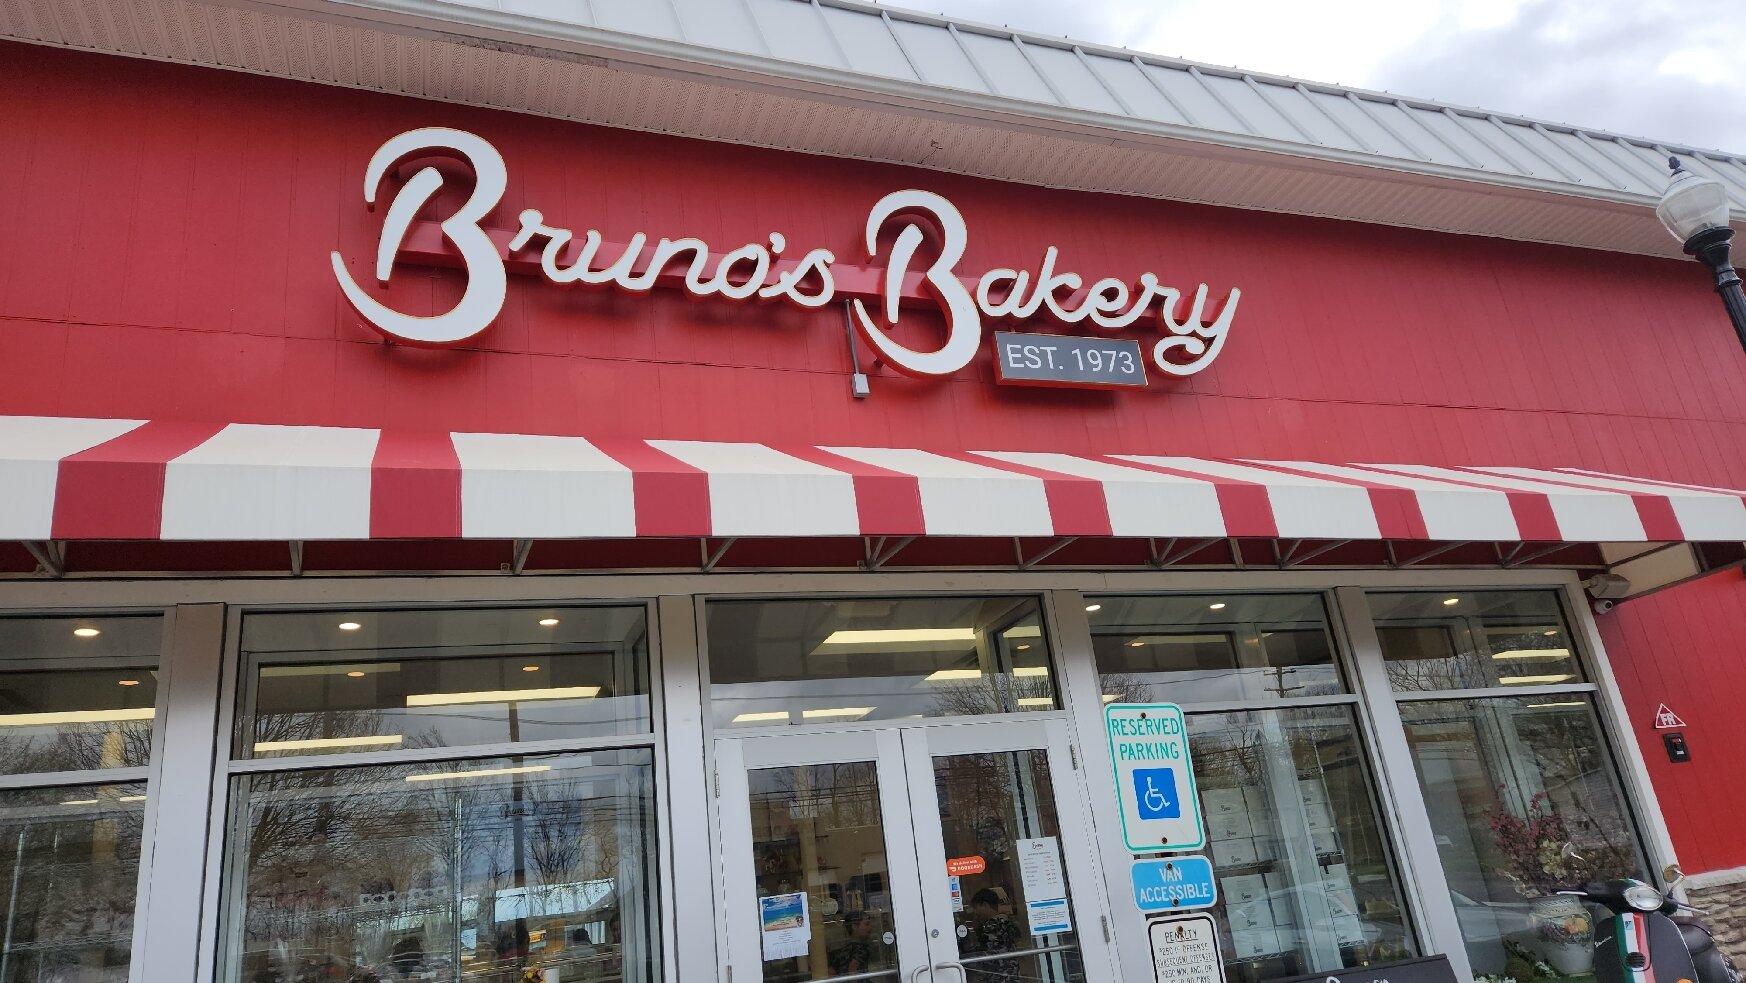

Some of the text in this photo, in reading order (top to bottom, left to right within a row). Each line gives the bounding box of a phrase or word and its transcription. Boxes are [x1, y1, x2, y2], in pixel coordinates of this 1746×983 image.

[331, 127, 1241, 376] Bruno's Bakery
[1006, 343, 1135, 374] EST. 1973
[1111, 717, 1180, 736] RESERVED
[1119, 741, 1180, 761] PARKING
[1159, 867, 1183, 882] VAN
[1140, 882, 1211, 903] ACCESSIBLE
[1165, 928, 1198, 942] PENALTY
[1182, 942, 1209, 953] OFFENSE
